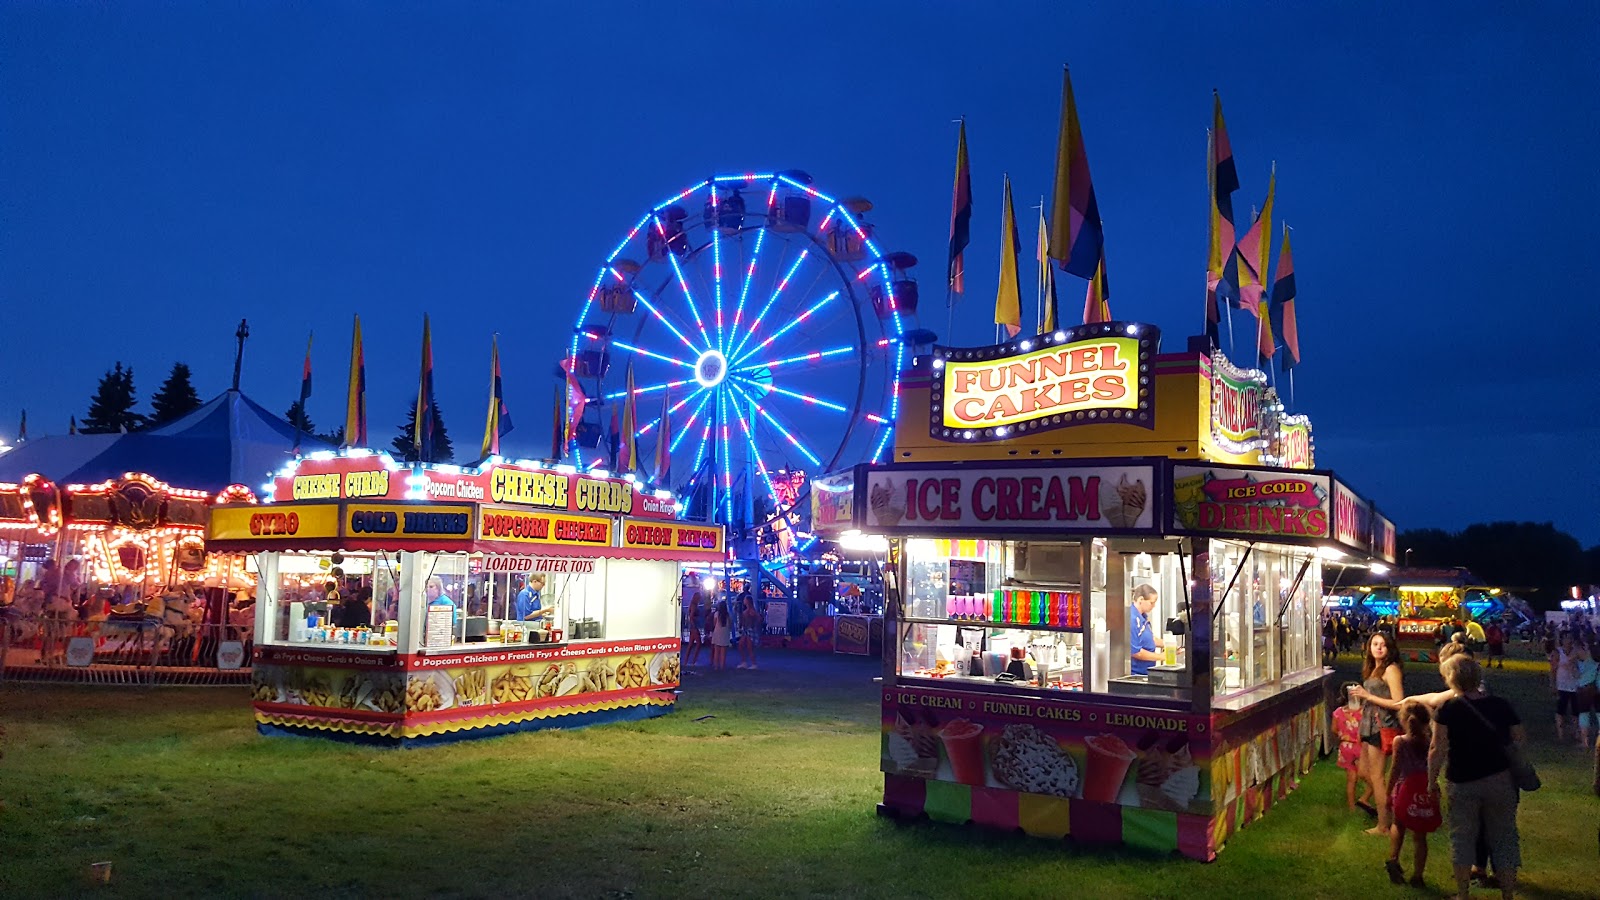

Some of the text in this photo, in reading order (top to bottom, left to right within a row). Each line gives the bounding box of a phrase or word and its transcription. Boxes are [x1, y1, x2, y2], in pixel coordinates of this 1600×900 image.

[956, 345, 1126, 393] FUNNEL
[953, 375, 1126, 422] CAKES
[1214, 378, 1259, 434] FUNNEL CAKES
[293, 470, 389, 500] CHEESE CURDS
[425, 476, 484, 499] Popcorn Chicken
[490, 467, 633, 514] CHEESE CURDS
[906, 476, 1101, 521] ICE CREAM
[1228, 481, 1307, 498] ICE COLD
[643, 499, 659, 512] Onion
[250, 512, 299, 535] GYRO
[352, 511, 468, 534] COLD DRINKS
[483, 514, 608, 543] POPCORN CHICKEN
[1199, 503, 1327, 536] DRINKS
[626, 524, 717, 548] ONION RINGS
[485, 557, 593, 573] LOADED TATER TOTS
[303, 653, 326, 662] Cheese
[327, 655, 347, 664] Curds
[354, 656, 376, 665] Onion
[423, 657, 461, 667] Popcorn
[463, 653, 498, 664] Chicken
[507, 651, 534, 661] French
[536, 650, 552, 659] Frys
[561, 648, 585, 657] Cheese
[586, 647, 606, 655] Curds
[613, 645, 633, 653] Onion
[657, 642, 672, 650] Gyro
[897, 693, 1188, 732] ICE CREAM FUNNEL CAKES LEMONADE
